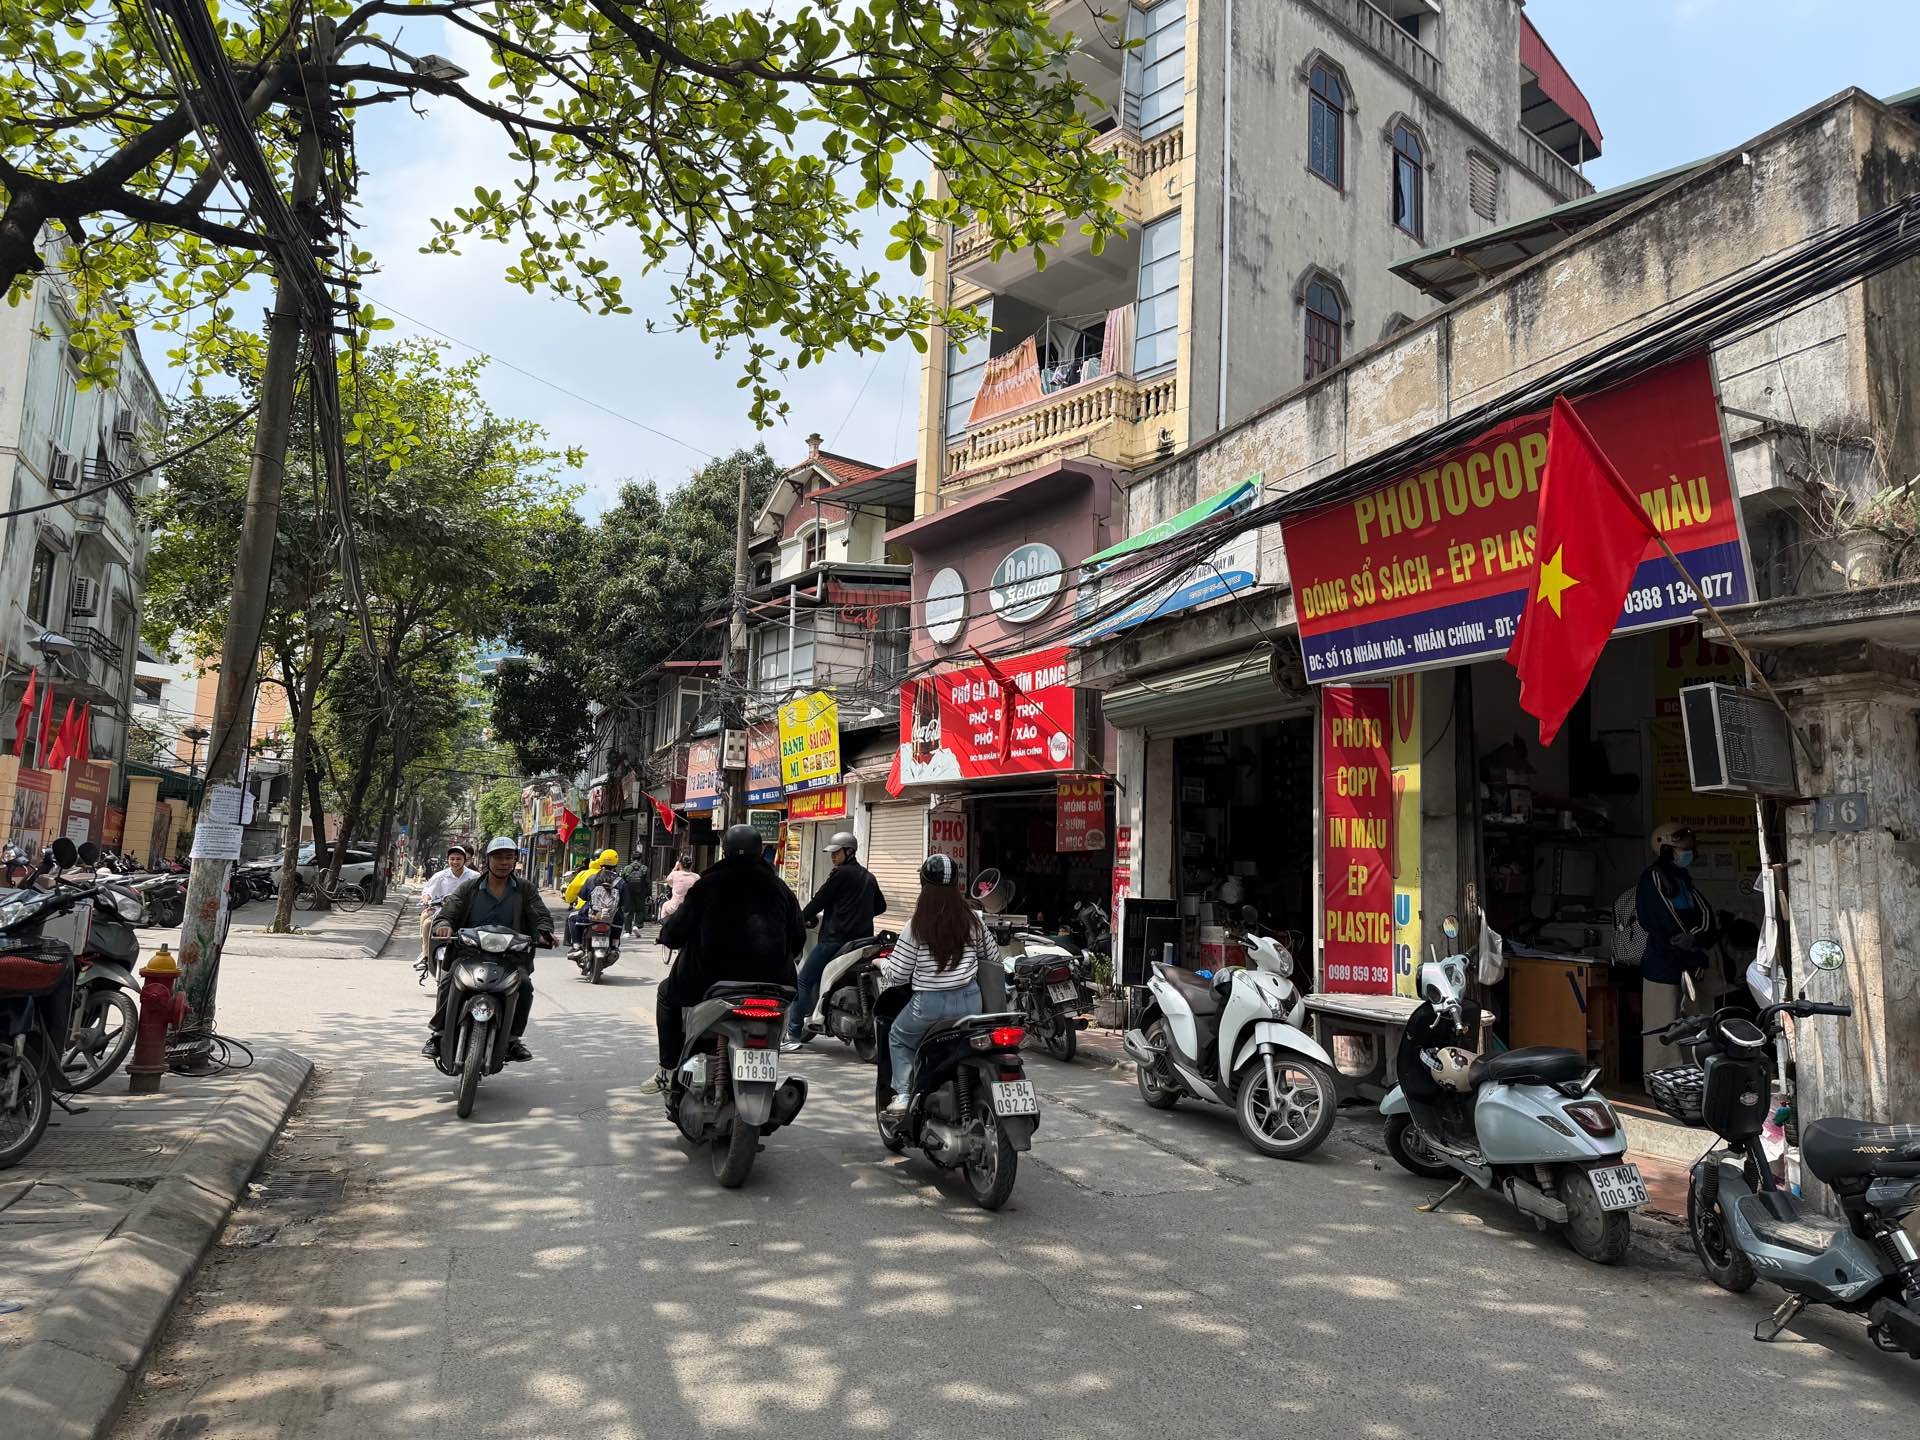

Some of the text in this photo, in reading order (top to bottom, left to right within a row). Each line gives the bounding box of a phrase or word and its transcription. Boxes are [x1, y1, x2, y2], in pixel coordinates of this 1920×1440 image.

[1354, 433, 1547, 544] PHOTOCOP
[1640, 474, 1712, 533] MÀU
[1301, 578, 1348, 619] ĐÓNG
[1351, 556, 1376, 607] SỔ
[1378, 555, 1432, 601] SÁCH
[1448, 538, 1476, 584] ÉP
[1481, 525, 1537, 575] PLAS
[1004, 580, 1048, 607] Gelato
[1309, 654, 1324, 672] ĐC:
[1326, 644, 1339, 668] SỐ
[1339, 649, 1352, 666] 18
[1353, 639, 1382, 664] NHÂN
[1383, 635, 1406, 659] HÒA
[1413, 627, 1446, 653] NHÂN
[1448, 621, 1485, 646] CHÍNH
[1495, 616, 1515, 638] ĐT:
[1624, 586, 1663, 614] 0388
[1666, 581, 1697, 606] 134
[1701, 571, 1733, 599] 077
[951, 679, 970, 704] PHỞ
[972, 675, 986, 701] GÀ
[1035, 664, 1066, 690] RANG
[969, 706, 988, 725] PHỞ
[974, 728, 993, 745] PHỞ
[1016, 723, 1037, 741] XÀO
[1332, 718, 1382, 749] PHOTO
[1336, 766, 1378, 798] COPY
[932, 815, 965, 842] PHỞ
[1329, 811, 1387, 850] IN MÀU
[1348, 859, 1368, 897] ÉP
[1326, 910, 1390, 945] PLASTIC
[1328, 964, 1389, 983] 0989 859 393
[737, 1065, 775, 1080] 018.90
[742, 1051, 772, 1066] 19-AK
[998, 1082, 1029, 1098] 15-B4
[997, 1098, 1036, 1114] 092.23
[1600, 1185, 1646, 1207] 009.36
